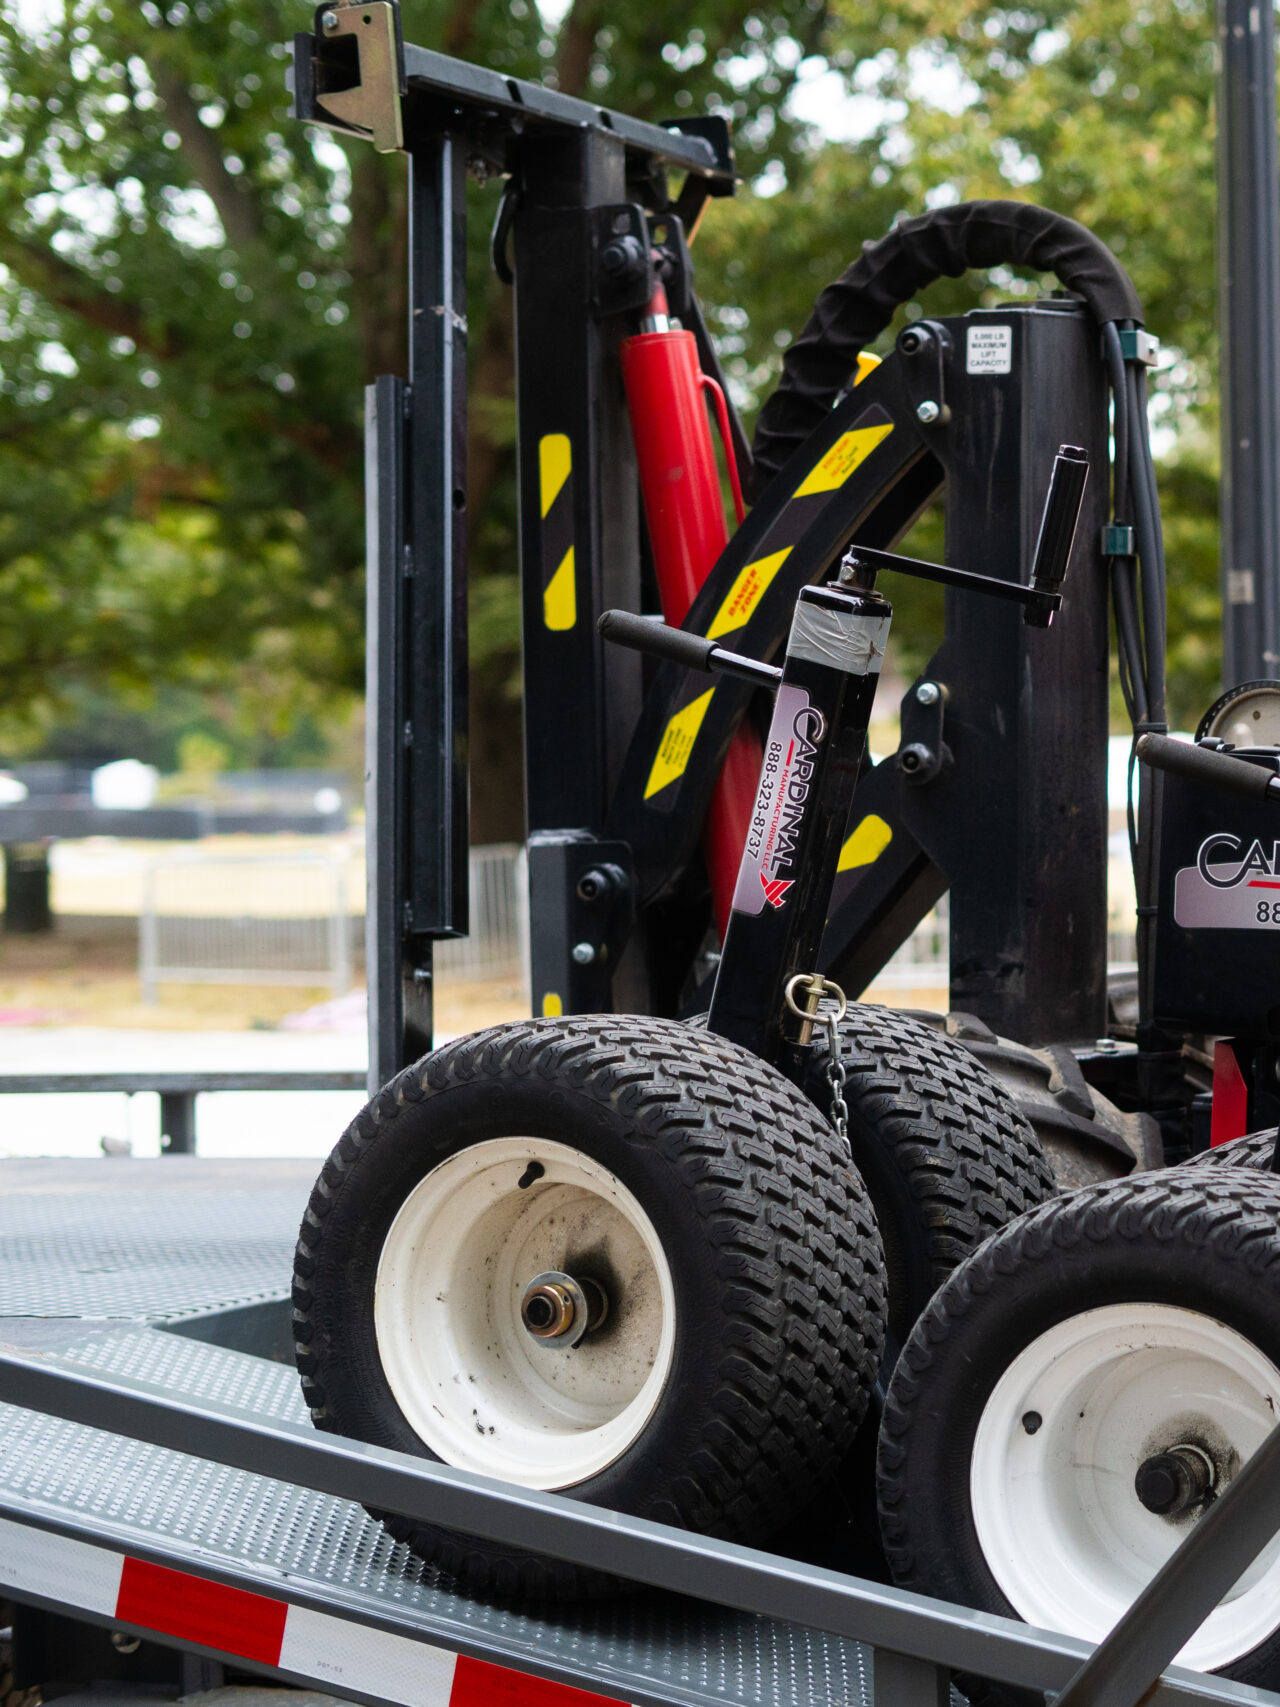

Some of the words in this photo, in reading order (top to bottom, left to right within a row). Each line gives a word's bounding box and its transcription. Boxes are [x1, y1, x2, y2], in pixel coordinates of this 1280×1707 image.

[728, 568, 757, 617] DANGER
[746, 741, 783, 860] 888-323-8737
[766, 769, 789, 852] MANUFACTURING
[770, 706, 827, 872] CARDINAL
[760, 849, 771, 870] LLC
